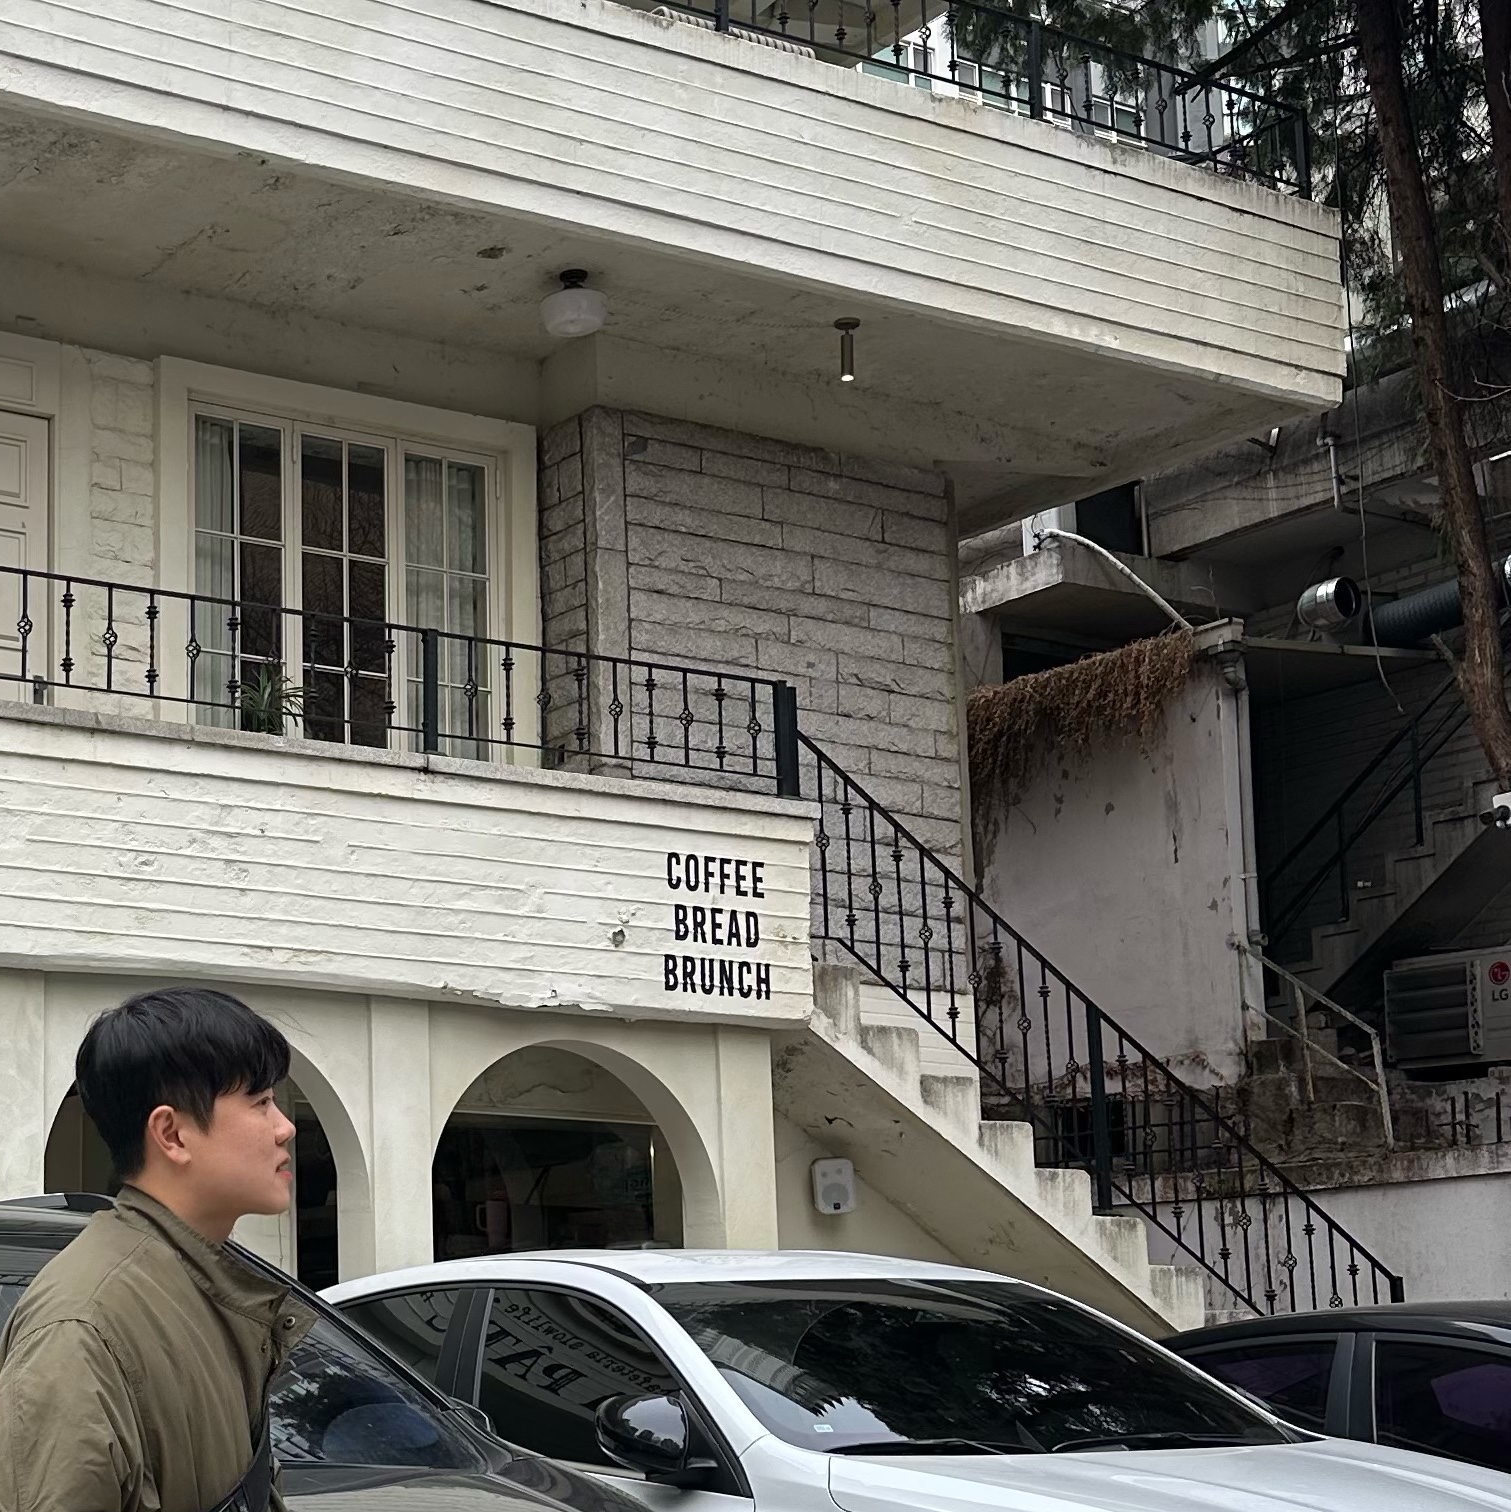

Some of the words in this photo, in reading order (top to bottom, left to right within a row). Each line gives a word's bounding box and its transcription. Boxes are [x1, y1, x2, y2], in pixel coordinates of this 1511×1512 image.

[666, 852, 765, 899] COFFEE
[674, 904, 760, 948] BREAD
[663, 954, 771, 1001] BRUNCH
[1492, 989, 1509, 1002] LG
